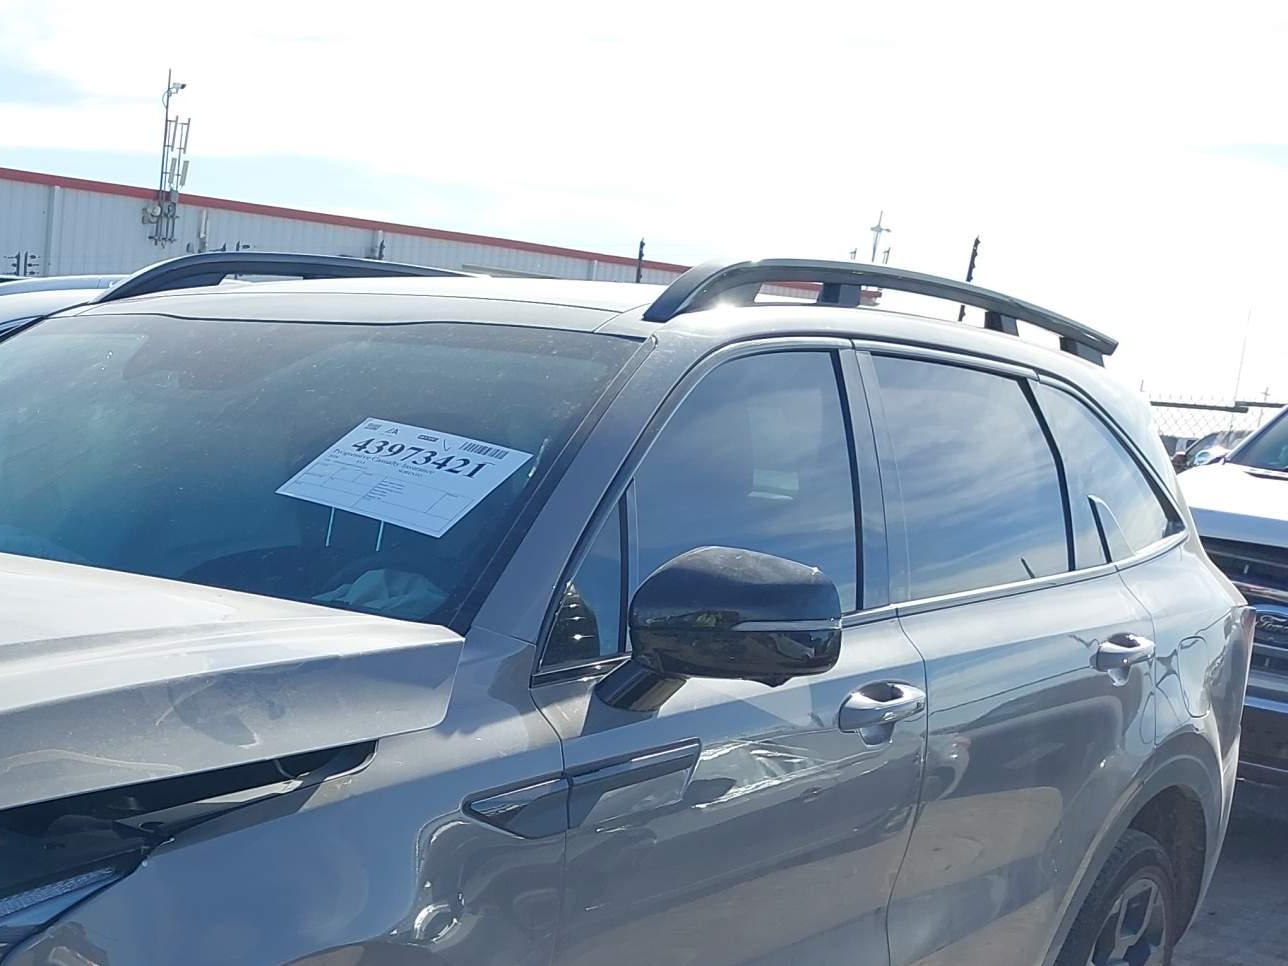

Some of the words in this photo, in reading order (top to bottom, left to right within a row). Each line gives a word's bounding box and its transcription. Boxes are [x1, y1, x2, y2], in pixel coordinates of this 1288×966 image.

[334, 448, 371, 463] Progressive
[371, 455, 400, 469] Casualty
[401, 463, 436, 475] Insurance
[351, 437, 489, 480] 43973421
